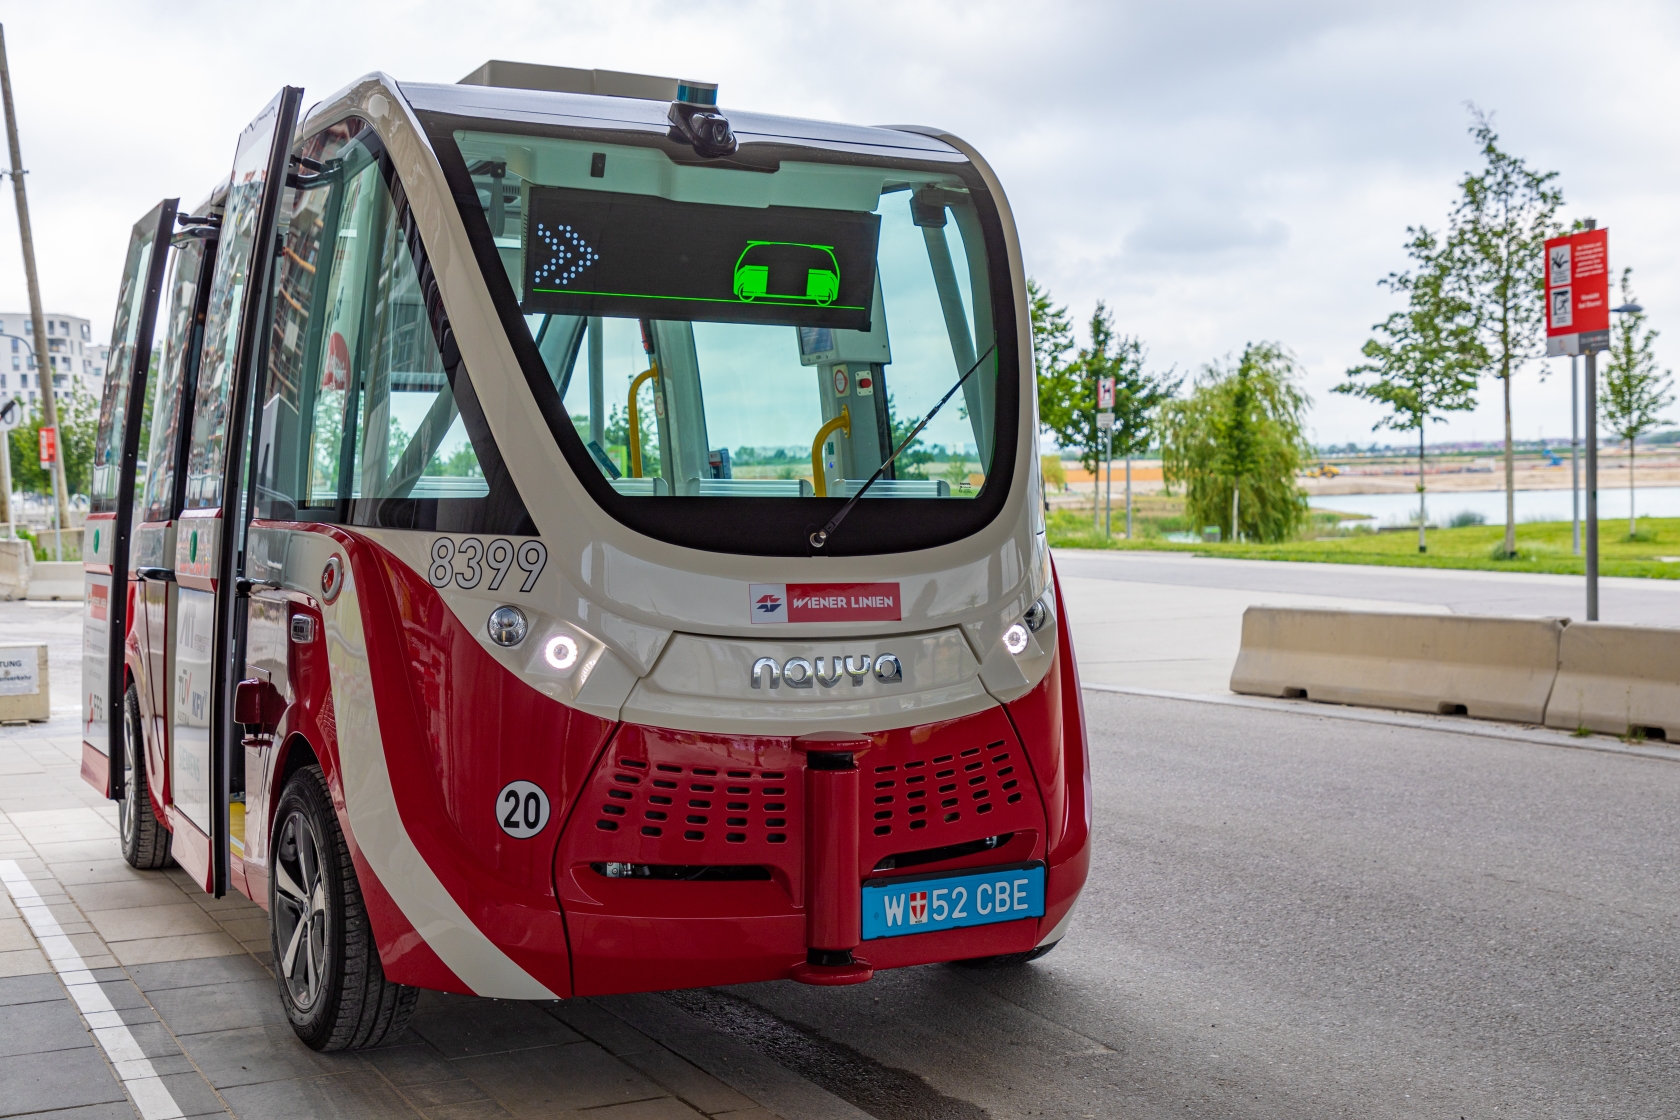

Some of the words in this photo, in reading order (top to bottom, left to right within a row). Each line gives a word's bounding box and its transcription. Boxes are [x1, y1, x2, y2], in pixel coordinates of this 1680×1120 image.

[428, 536, 548, 593] 8399
[793, 596, 847, 609] WIENER
[851, 596, 893, 608] LINIEN
[503, 789, 541, 829] 20
[884, 893, 906, 927] W
[932, 886, 968, 921] 52
[976, 878, 1029, 915] CBE
